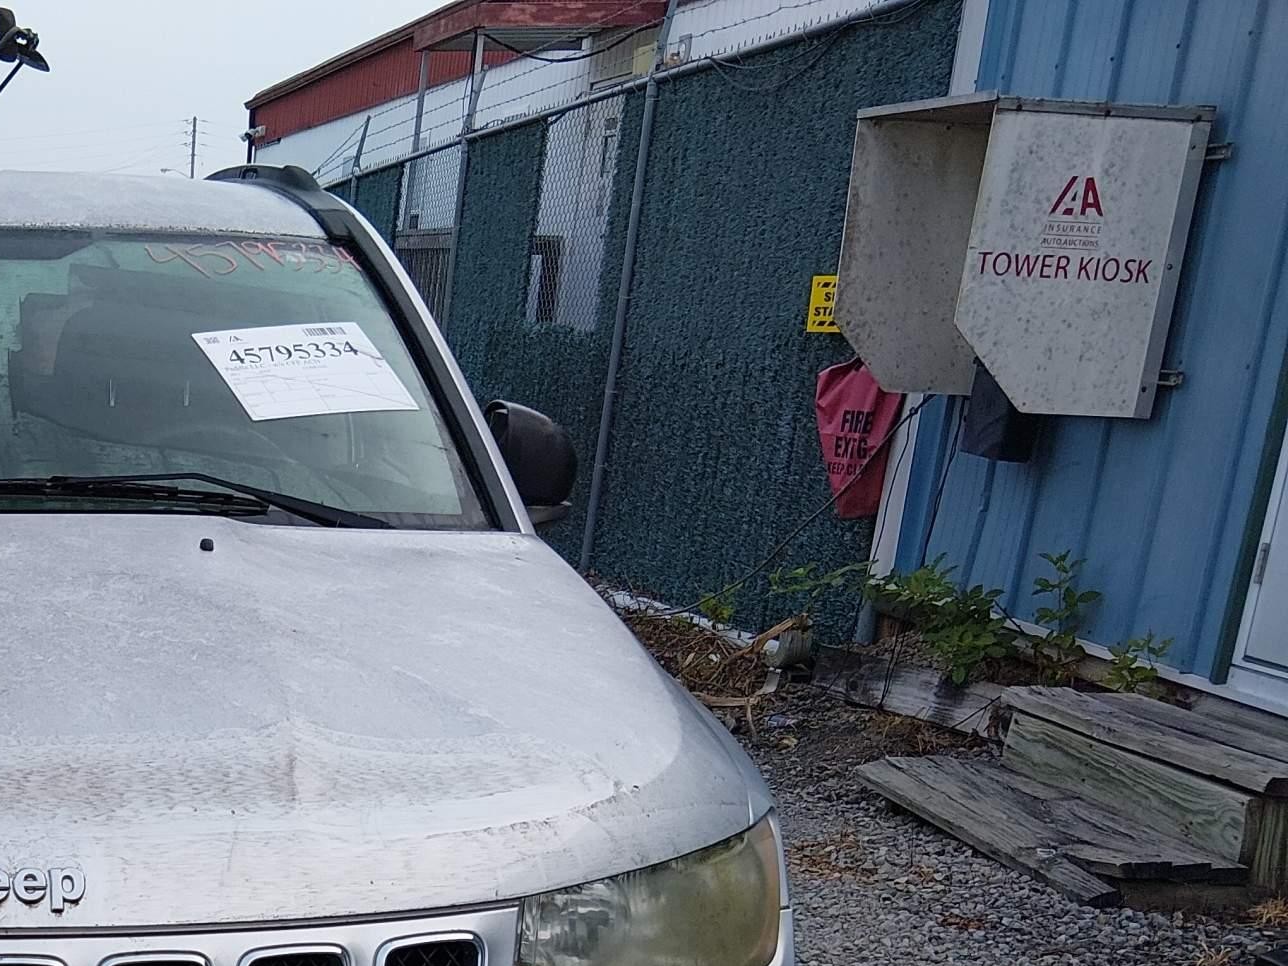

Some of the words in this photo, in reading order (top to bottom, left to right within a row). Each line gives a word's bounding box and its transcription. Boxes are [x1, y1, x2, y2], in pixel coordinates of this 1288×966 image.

[1043, 222, 1103, 236] INSURANCE
[1041, 237, 1061, 247] AUTO
[1061, 239, 1099, 250] AUCTIONS
[977, 250, 1070, 280] TOWER
[1077, 256, 1153, 284] KIOSK
[228, 340, 360, 366] 45795334
[840, 409, 873, 434] FIRE
